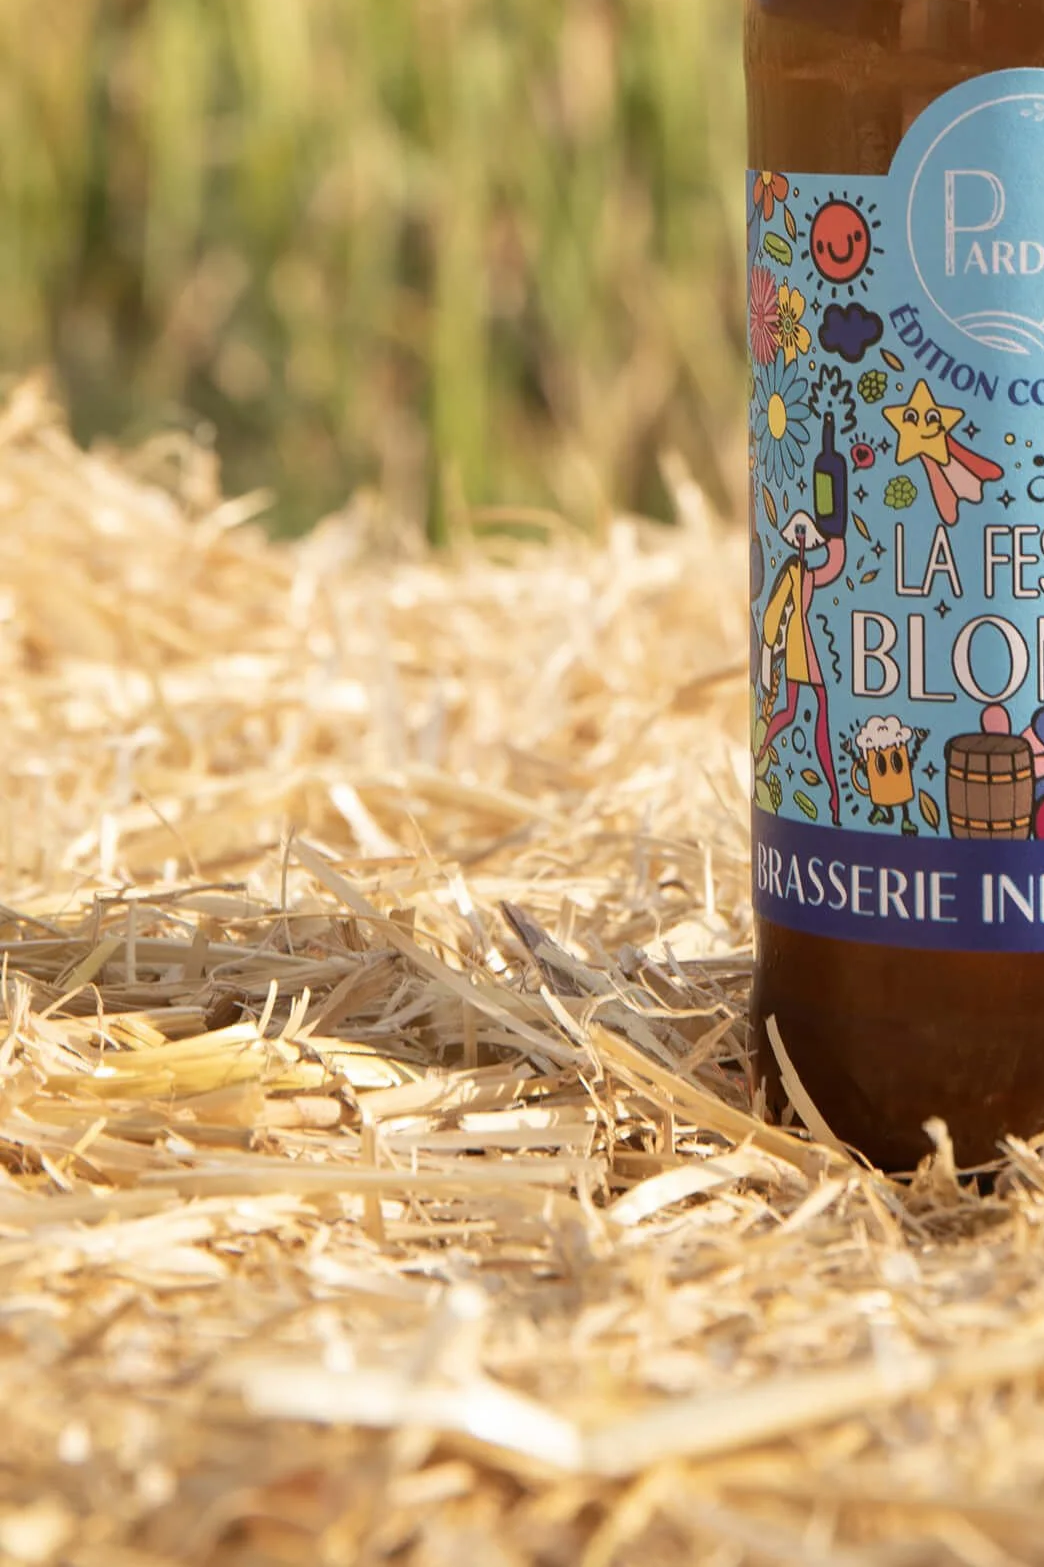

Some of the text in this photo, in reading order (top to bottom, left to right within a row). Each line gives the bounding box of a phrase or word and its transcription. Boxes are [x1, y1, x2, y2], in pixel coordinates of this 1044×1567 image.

[889, 302, 997, 403] ÉDITION
[895, 522, 962, 597] LA
[756, 841, 957, 923] BRASSERIE
